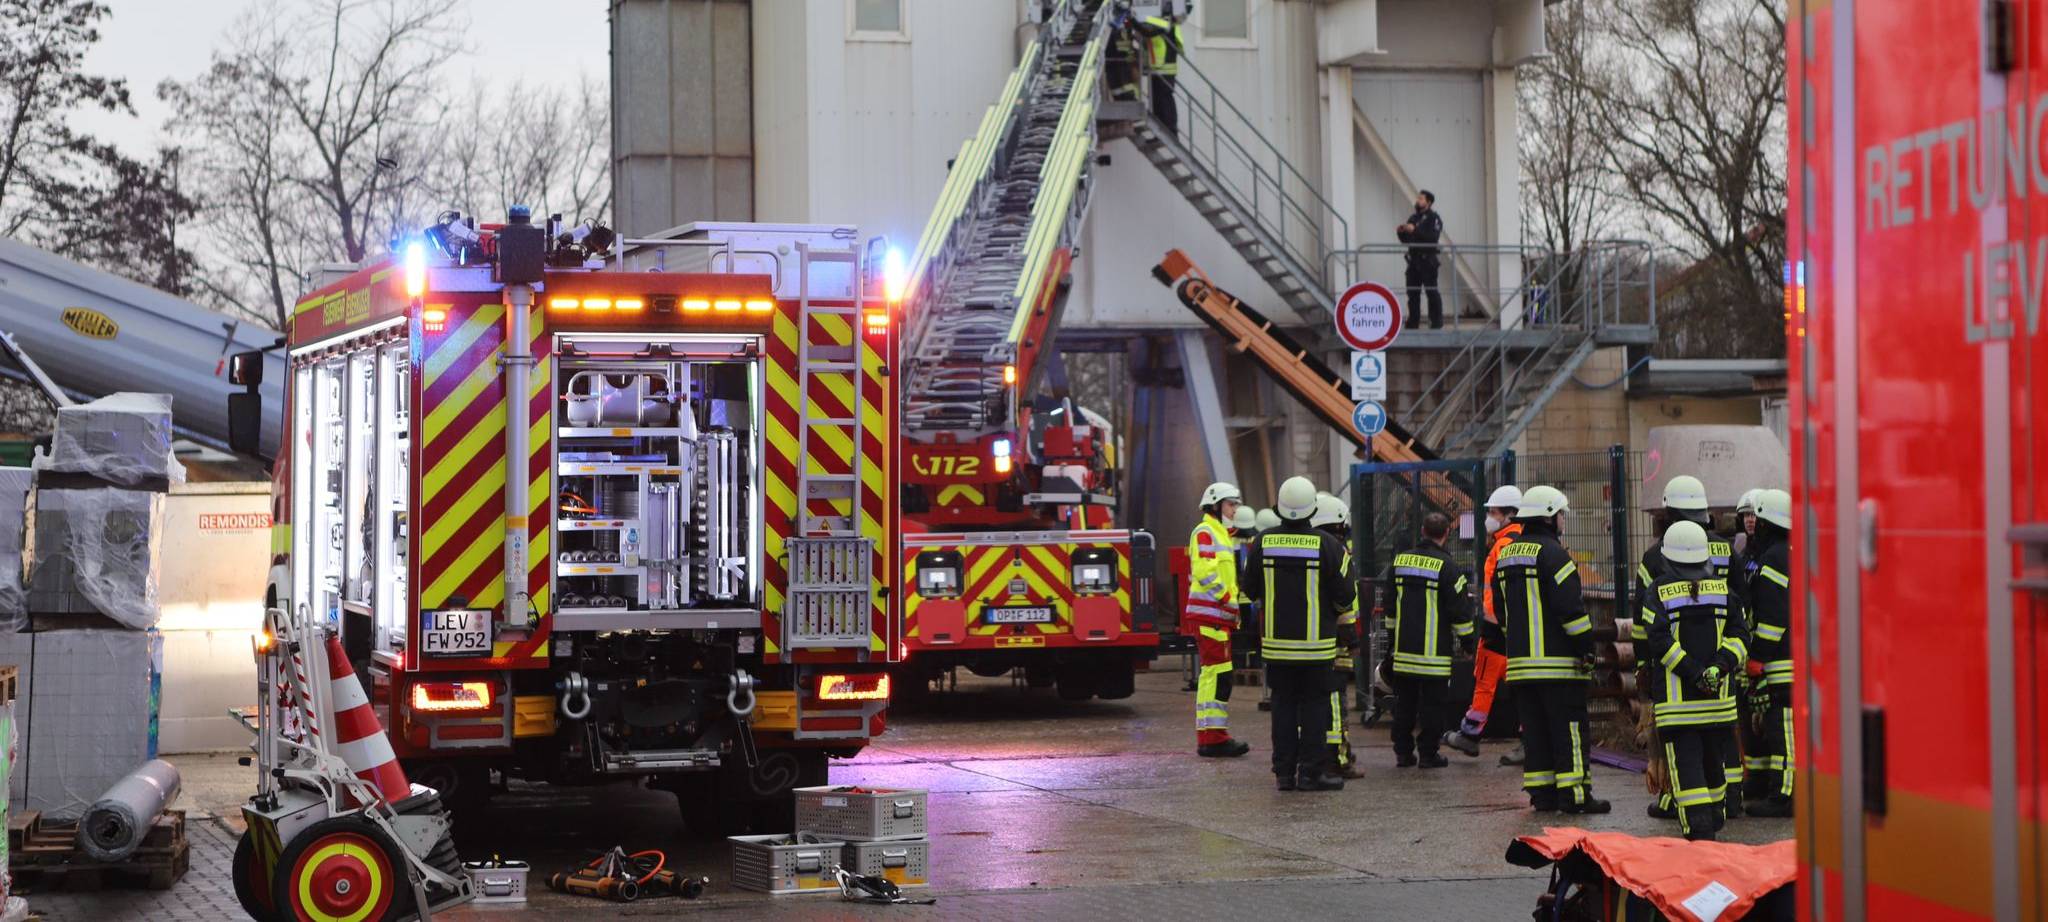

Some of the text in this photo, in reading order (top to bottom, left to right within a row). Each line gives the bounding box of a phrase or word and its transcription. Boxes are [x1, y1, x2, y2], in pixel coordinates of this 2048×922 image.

[1964, 237, 2048, 344] LEV
[1352, 303, 1385, 314] Schritt
[64, 311, 115, 337] MEILLER
[1352, 317, 1385, 328] fahren
[929, 456, 980, 475] 112
[200, 514, 269, 529] REMONDIS
[1263, 536, 1319, 547] FEUERWEHR
[435, 614, 468, 630] LEV
[1026, 610, 1046, 620] 112
[427, 632, 486, 649] FW 952
